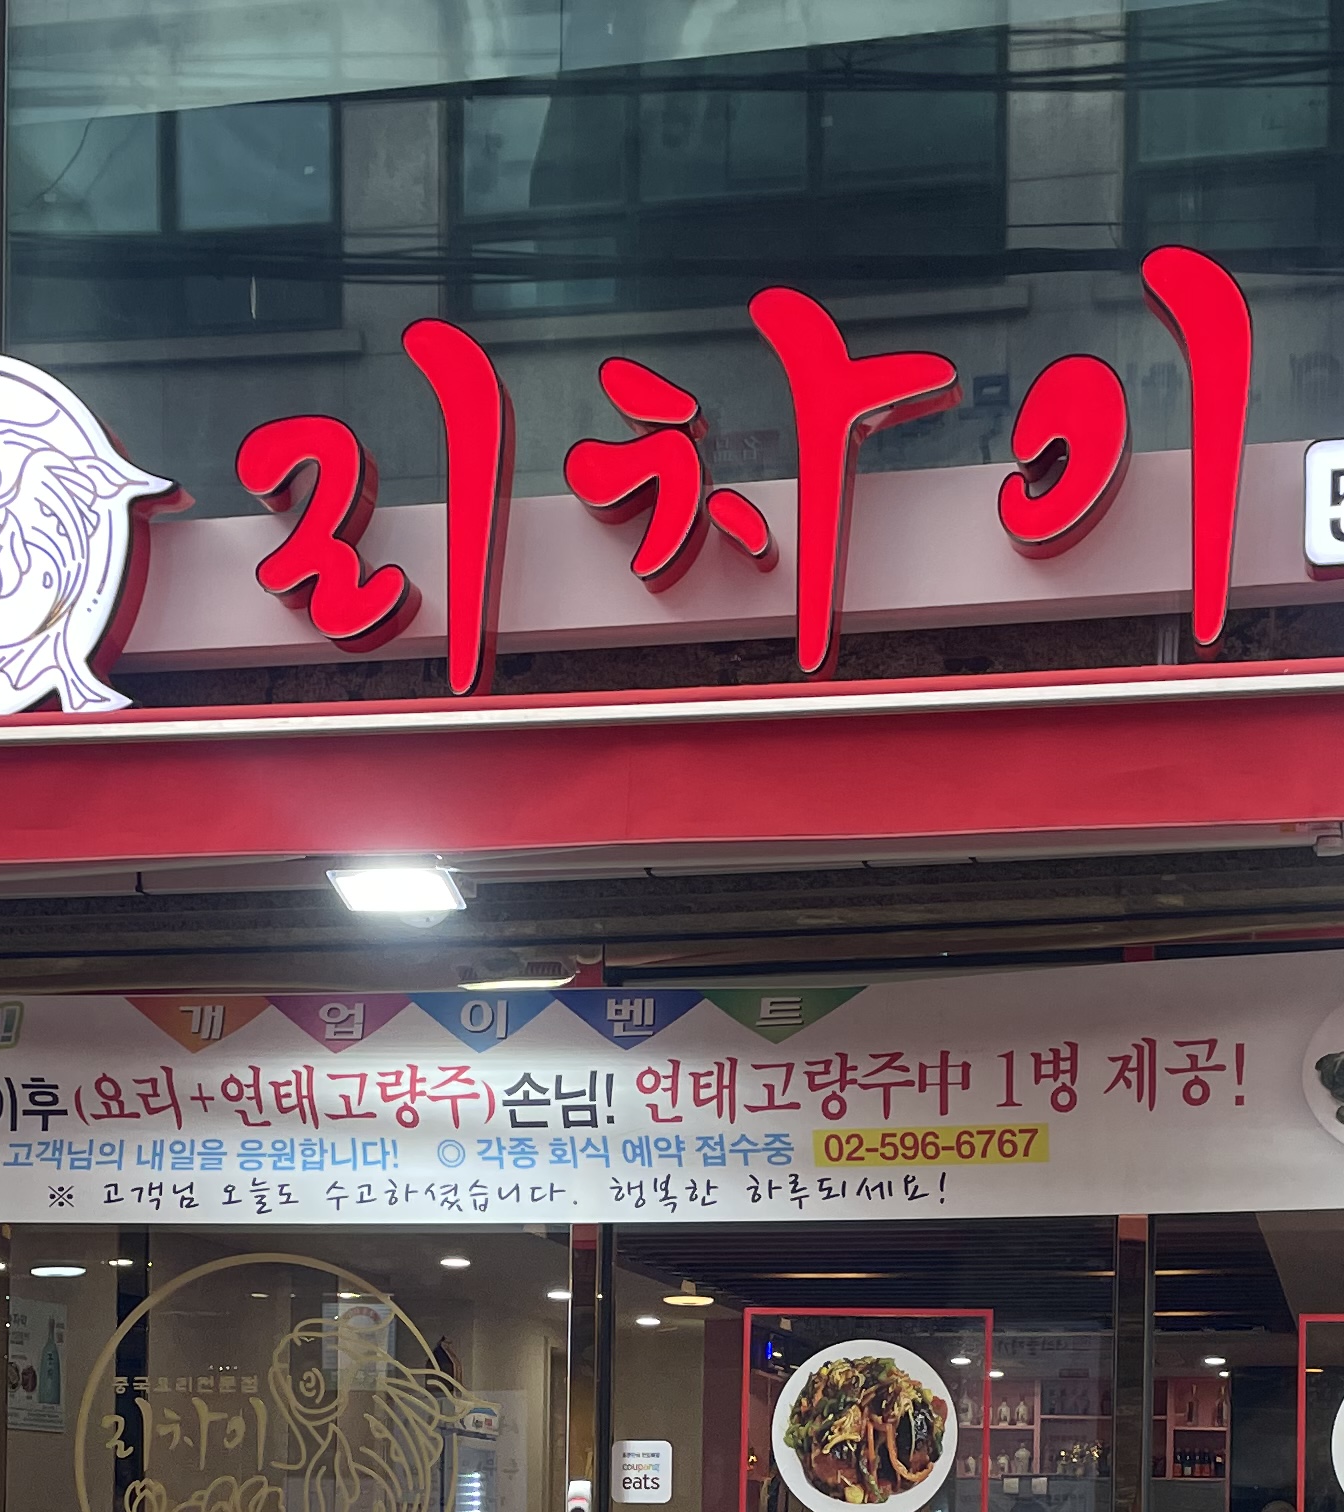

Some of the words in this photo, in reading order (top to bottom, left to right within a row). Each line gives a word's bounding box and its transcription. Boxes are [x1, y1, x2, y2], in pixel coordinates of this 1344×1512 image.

[236, 244, 1253, 697] 리차이
[635, 1049, 973, 1125] 연태고량주中
[996, 1041, 1080, 1115] 1병
[1103, 1037, 1247, 1112] 제공!
[2, 1139, 124, 1171] 고객님의
[136, 1138, 225, 1172] 내일을
[236, 1137, 399, 1172] 응원합니다!
[476, 1137, 538, 1171] 각종
[548, 1135, 613, 1171] 회식
[621, 1135, 686, 1169] 예약
[694, 1131, 795, 1168] 접수중
[823, 1128, 1040, 1163] 02-596-6767
[103, 1180, 200, 1209] 고객님
[222, 1178, 300, 1213] 오늘도
[610, 1173, 719, 1214] 행복한
[747, 1172, 947, 1209] 하루되세요!
[101, 1397, 269, 1471] 리차이
[622, 1474, 661, 1491] eats
